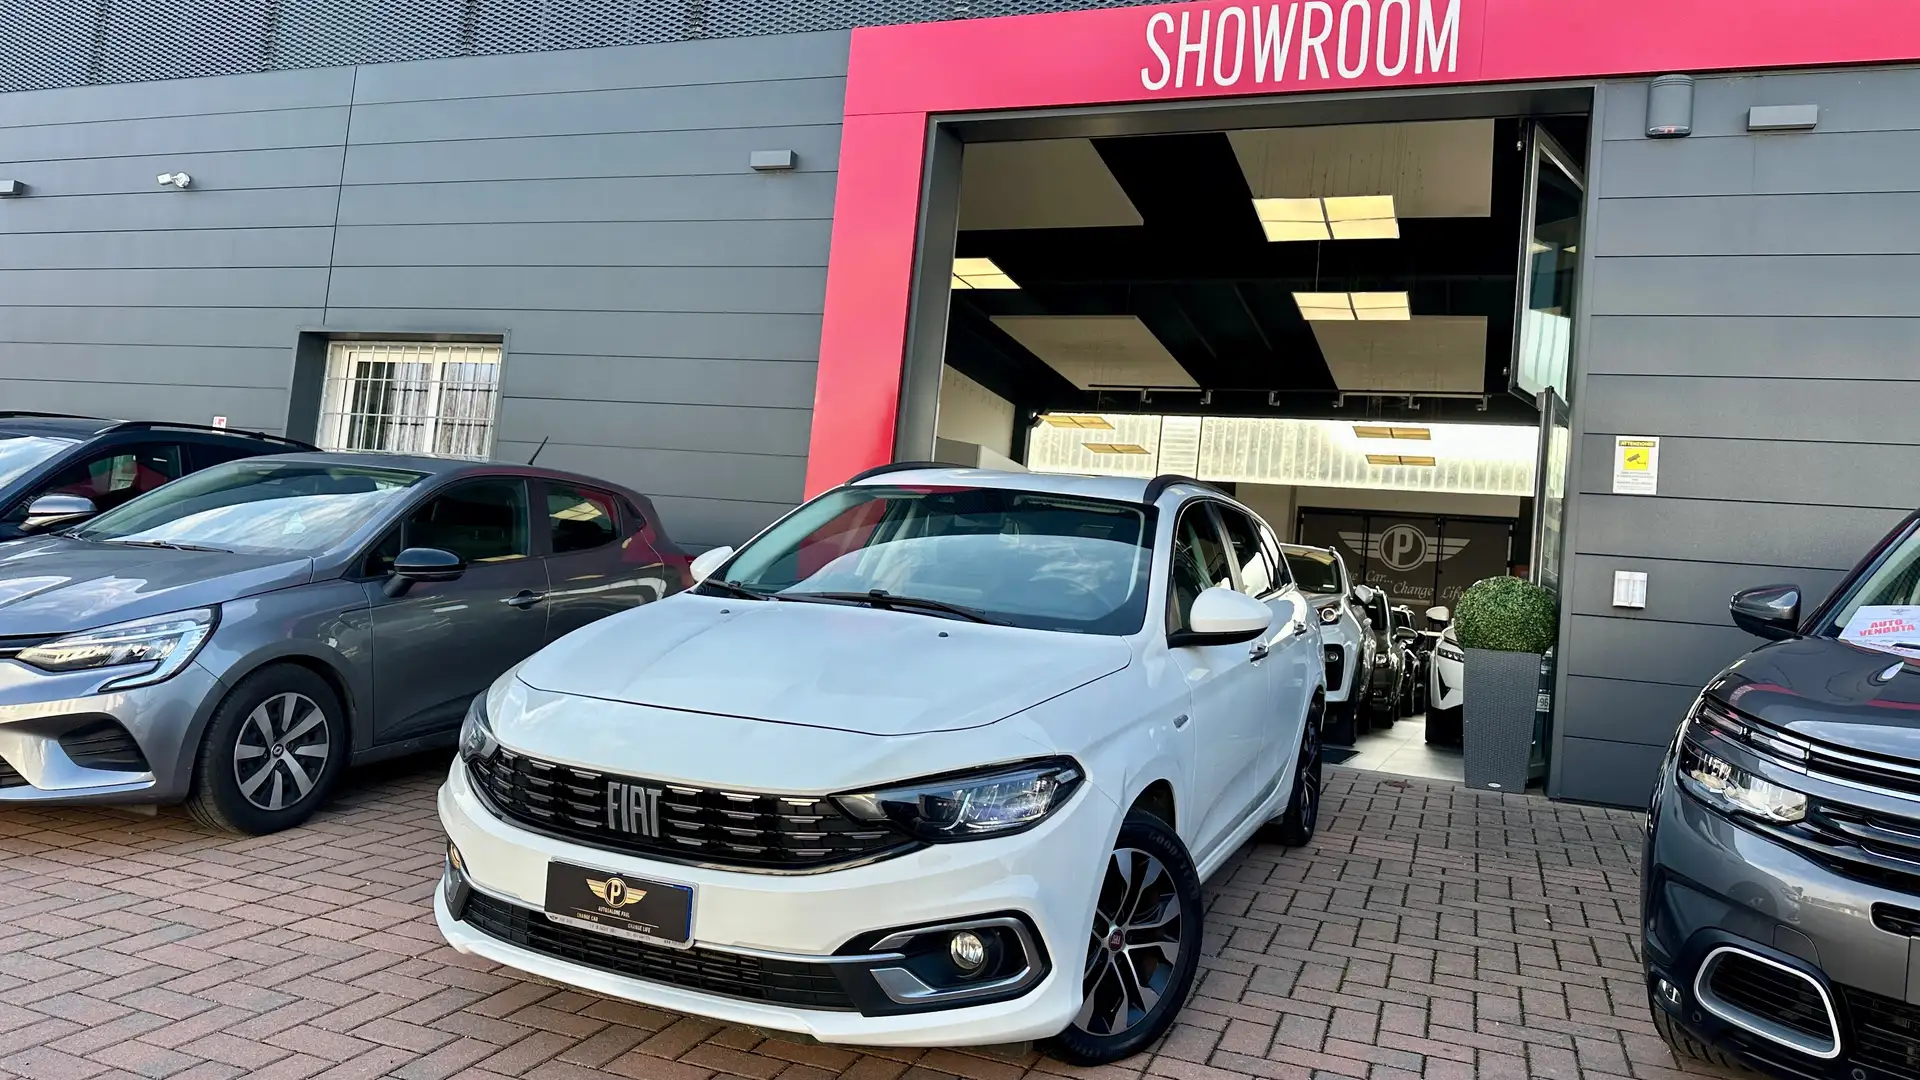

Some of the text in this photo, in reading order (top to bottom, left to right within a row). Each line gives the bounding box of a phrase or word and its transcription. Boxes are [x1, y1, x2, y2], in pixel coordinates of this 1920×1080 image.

[1140, 0, 1461, 91] SHOWROOM
[1392, 529, 1414, 566] P
[1393, 580, 1434, 599] Change
[1859, 624, 1915, 636] VENDUTA
[1870, 619, 1903, 629] AUTO
[607, 781, 663, 838] FIAT
[576, 912, 590, 921] CHANGE
[627, 923, 642, 932] CHANGE
